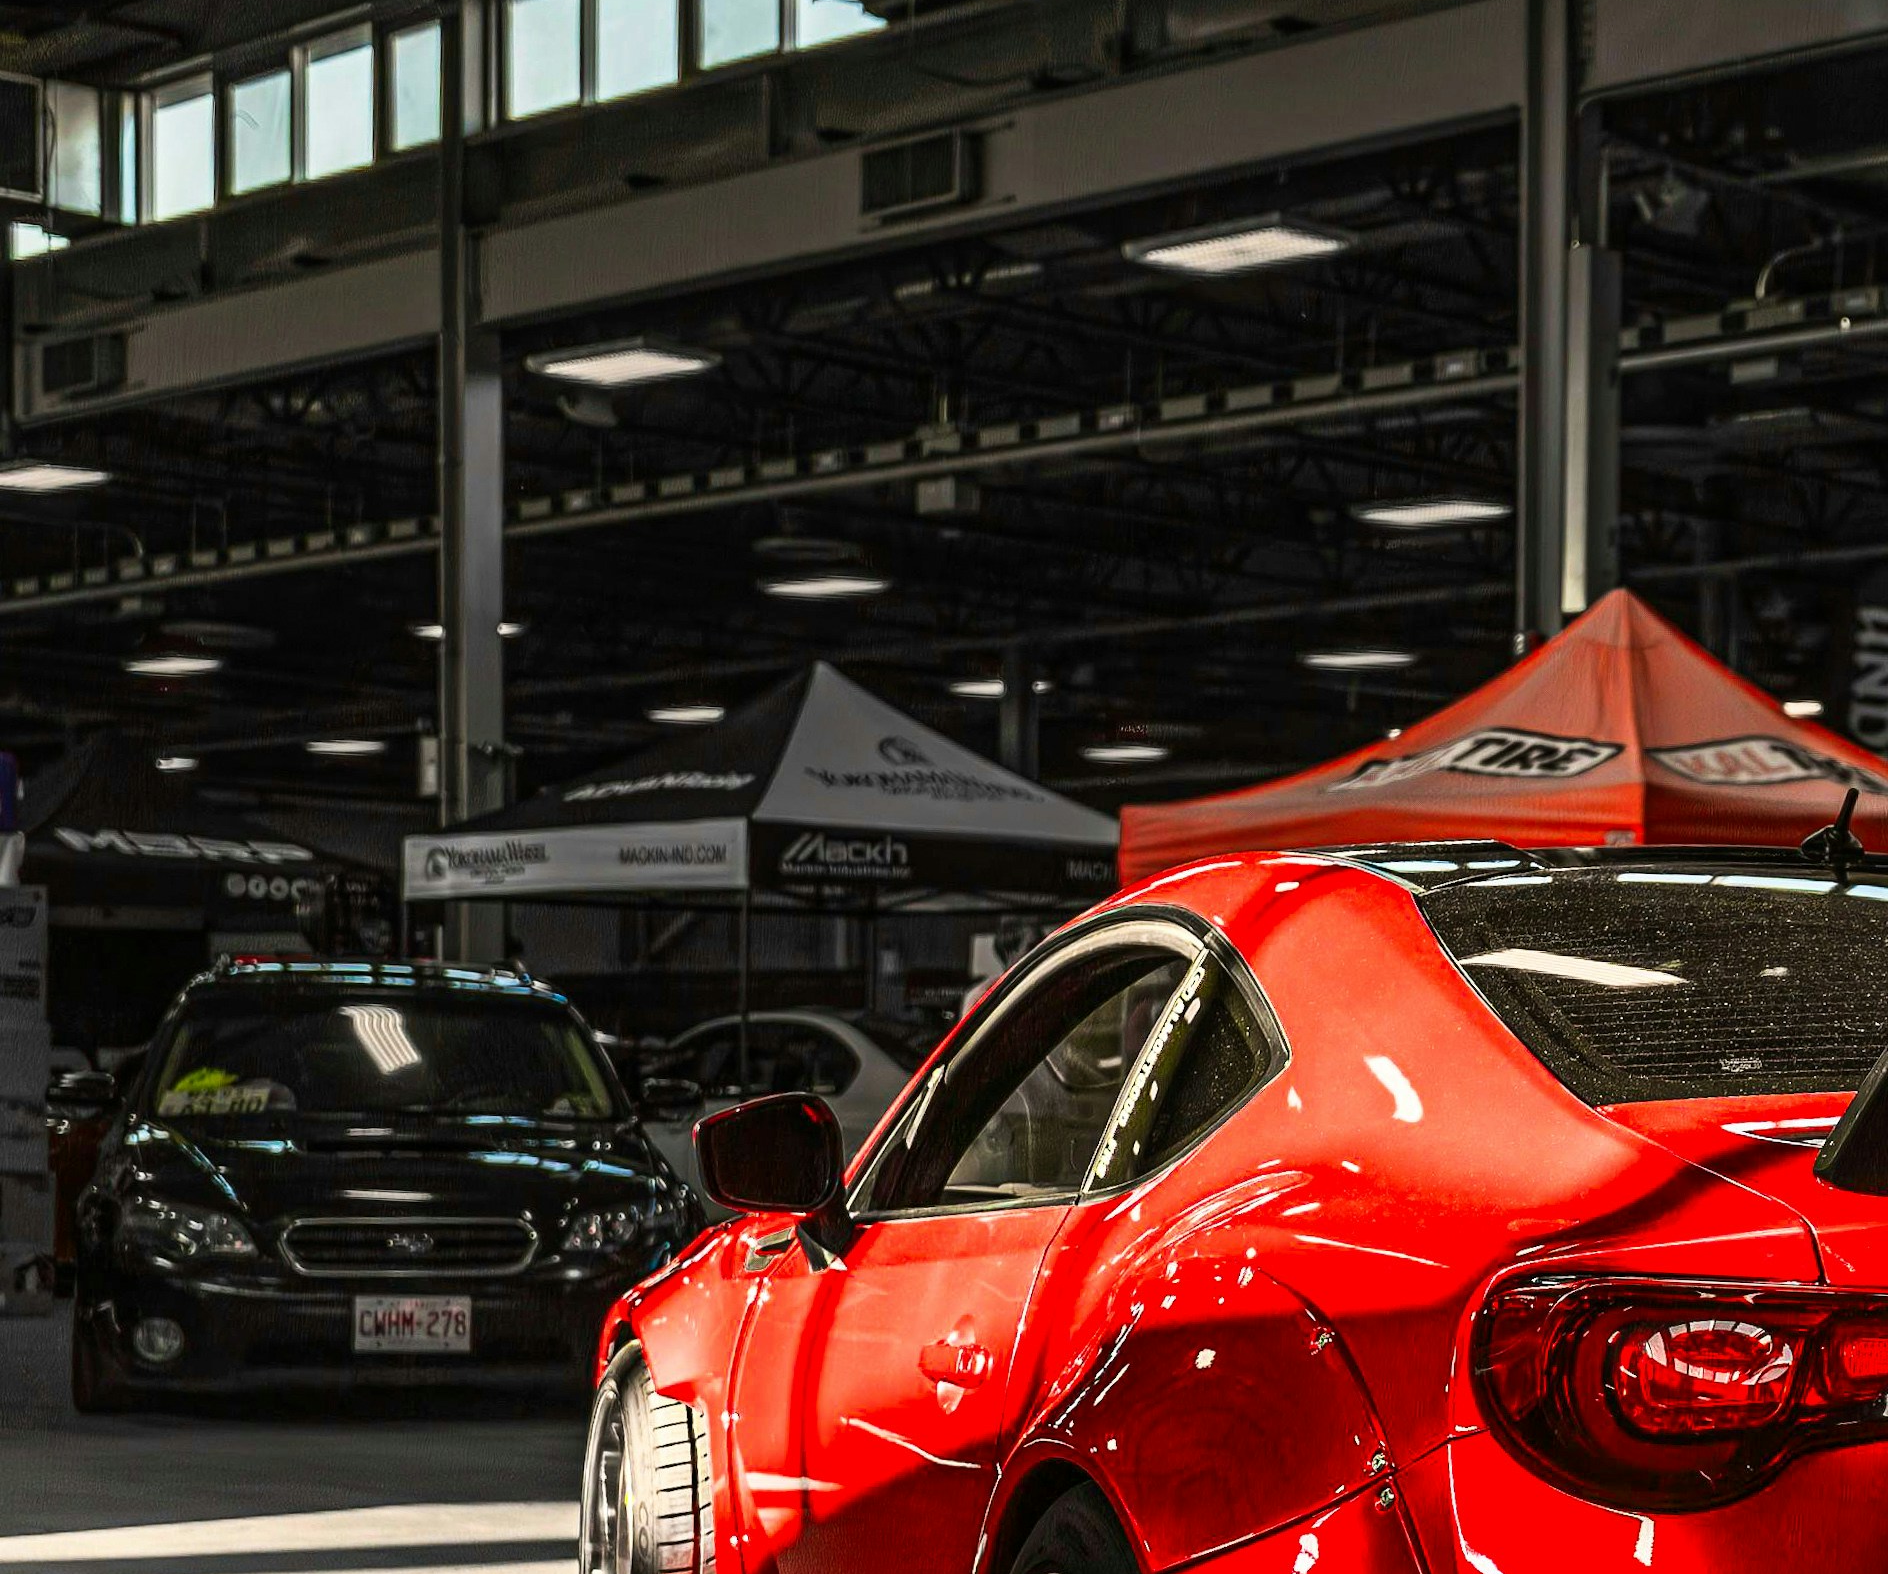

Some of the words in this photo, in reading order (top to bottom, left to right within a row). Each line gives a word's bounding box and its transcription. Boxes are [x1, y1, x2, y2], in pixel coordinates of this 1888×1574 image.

[1455, 736, 1597, 771] TIRE
[1669, 747, 1784, 783] KAL
[360, 1309, 414, 1337] CWHM
[426, 1310, 467, 1337] 278
